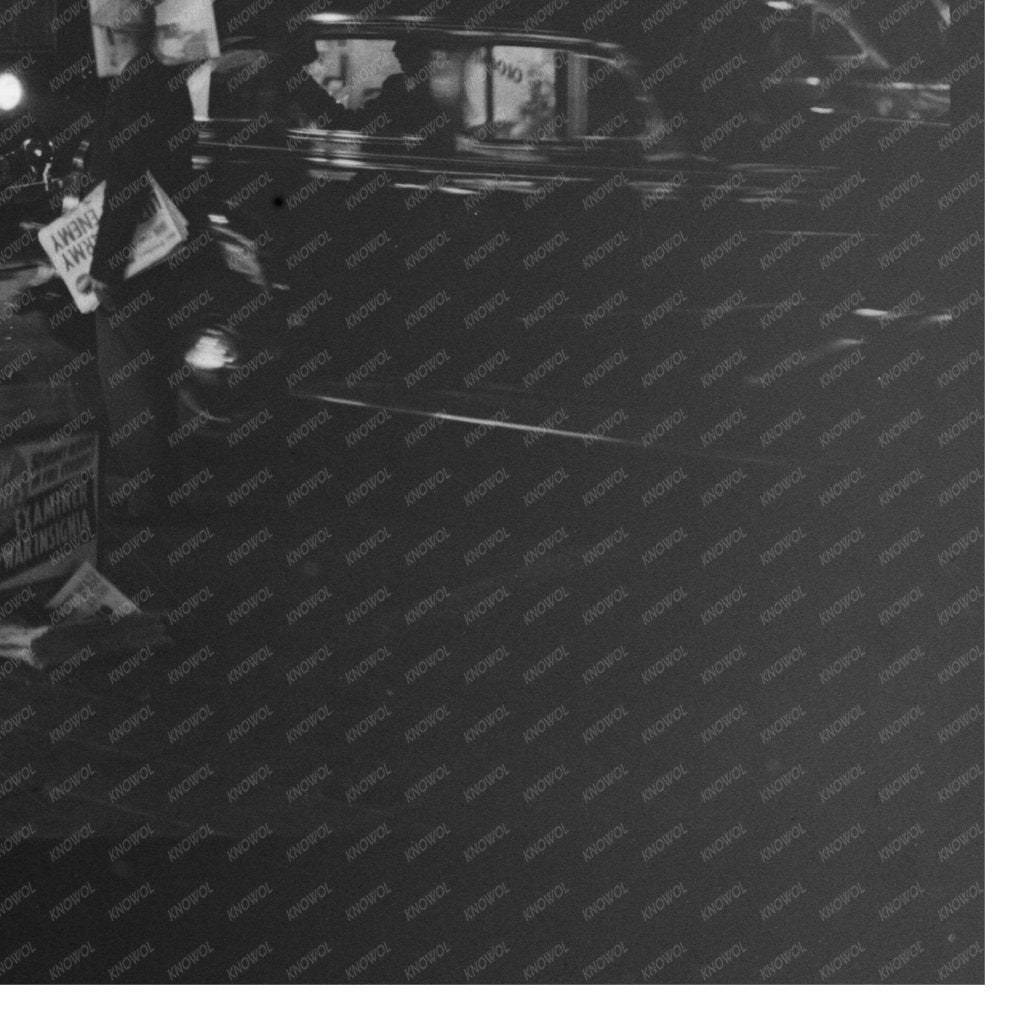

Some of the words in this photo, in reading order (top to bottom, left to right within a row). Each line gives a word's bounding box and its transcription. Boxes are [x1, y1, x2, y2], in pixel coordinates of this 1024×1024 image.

[50, 208, 101, 254] ENEMY
[14, 481, 89, 534] EXAMINER
[1, 539, 33, 570] WAR
